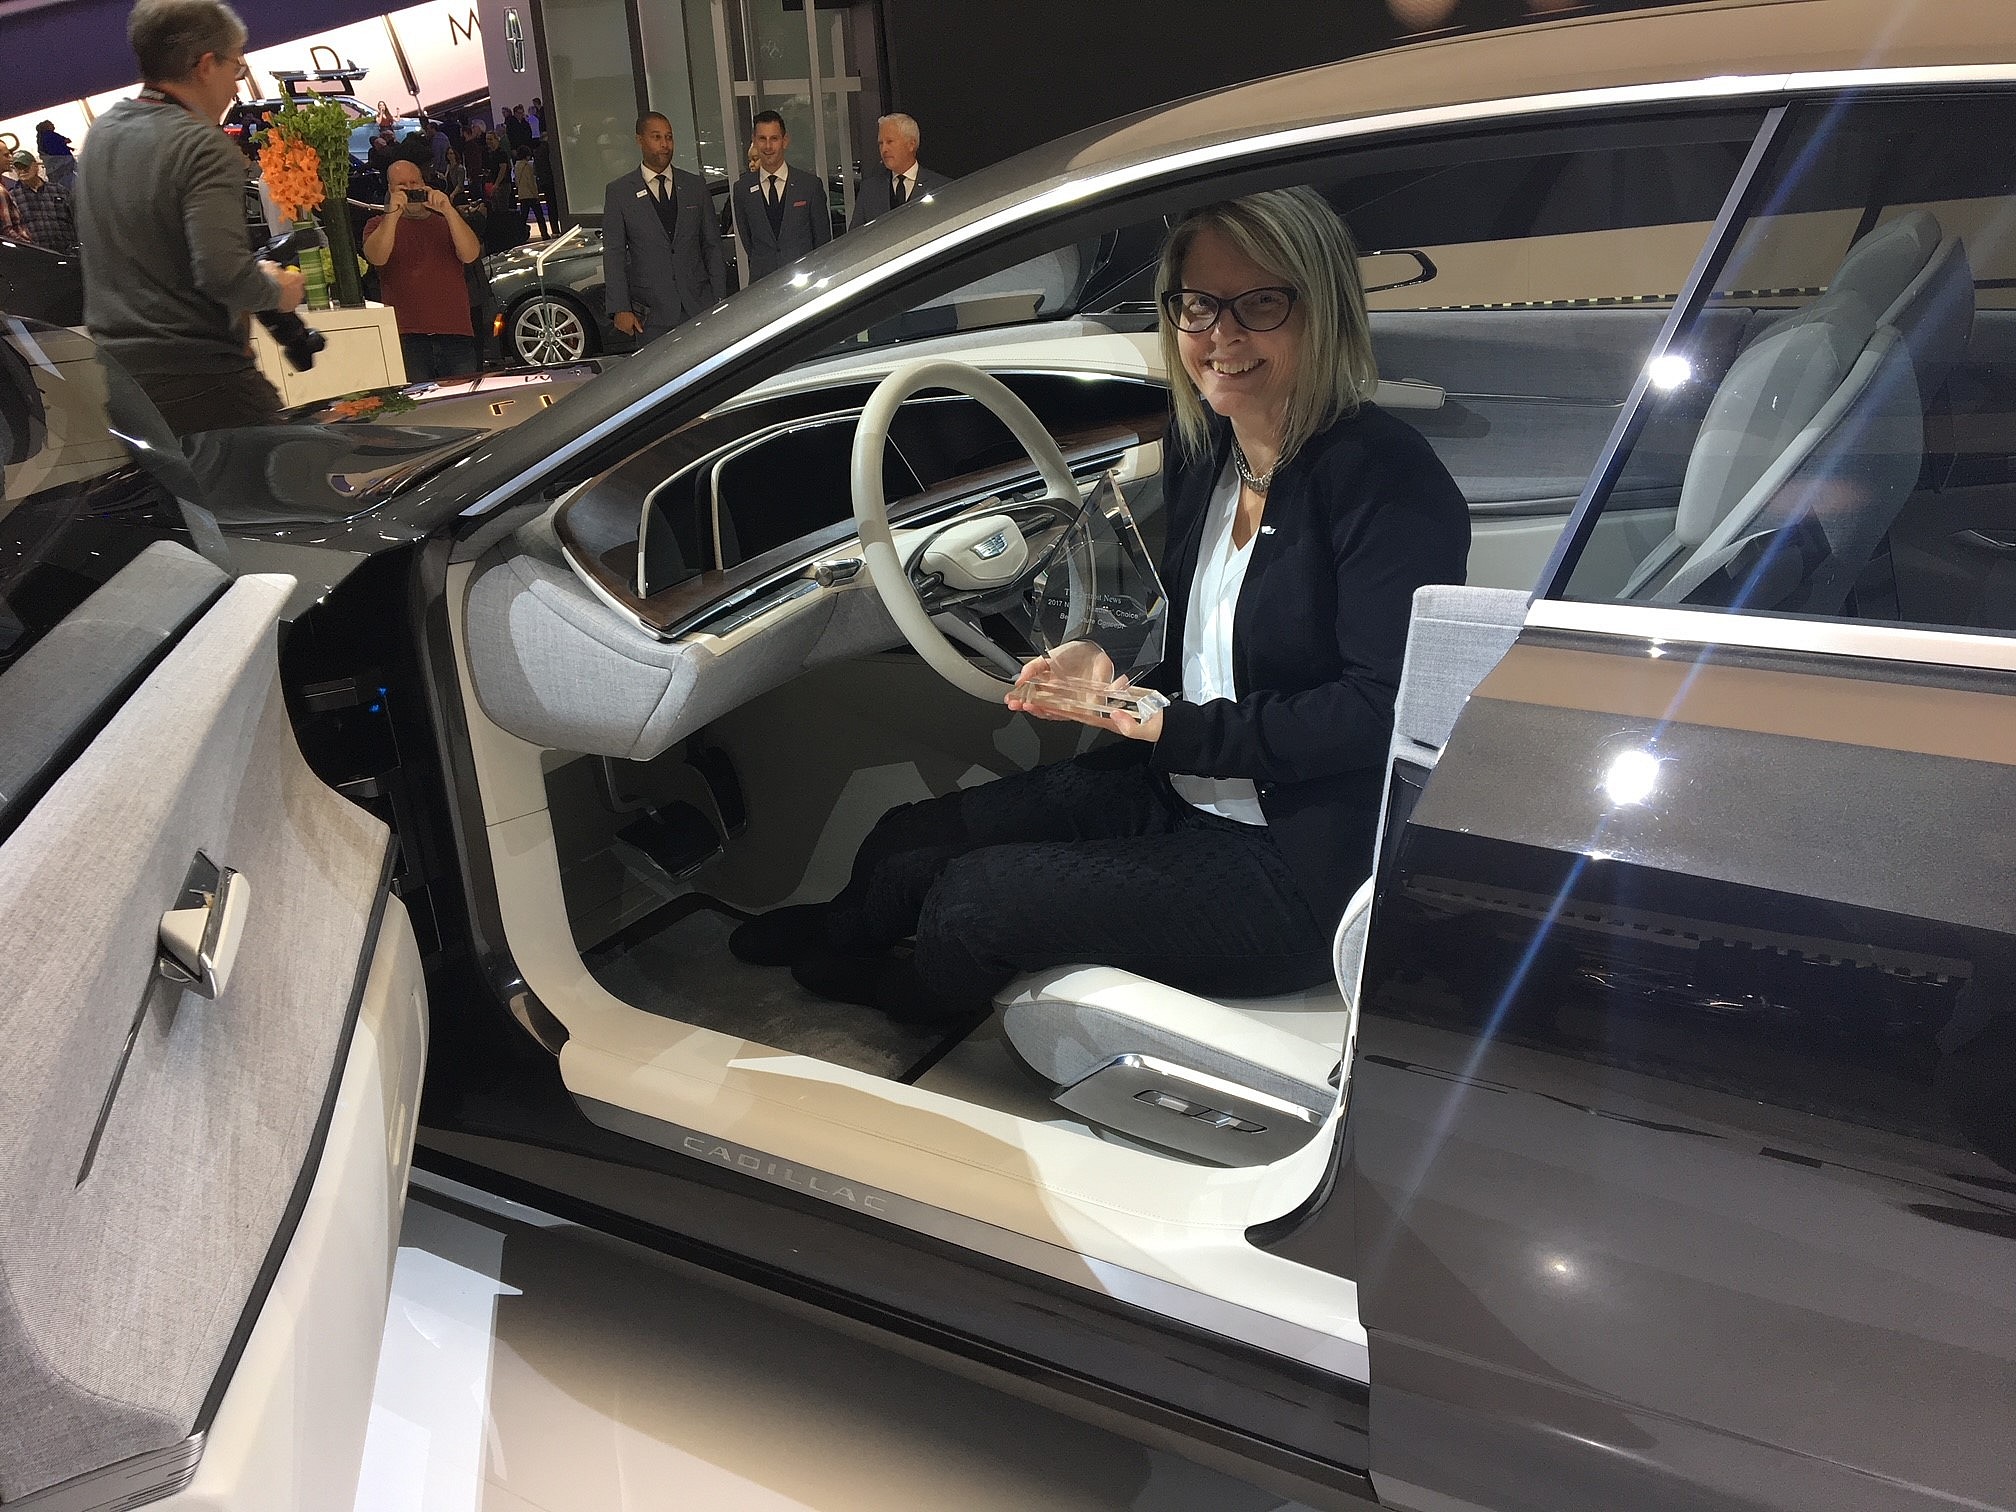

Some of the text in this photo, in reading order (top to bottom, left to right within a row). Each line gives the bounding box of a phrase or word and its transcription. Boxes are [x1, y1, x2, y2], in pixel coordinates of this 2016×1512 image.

[1047, 598, 1063, 607] 2017
[1115, 609, 1139, 620] Choice
[683, 1136, 887, 1212] CADILLAC
